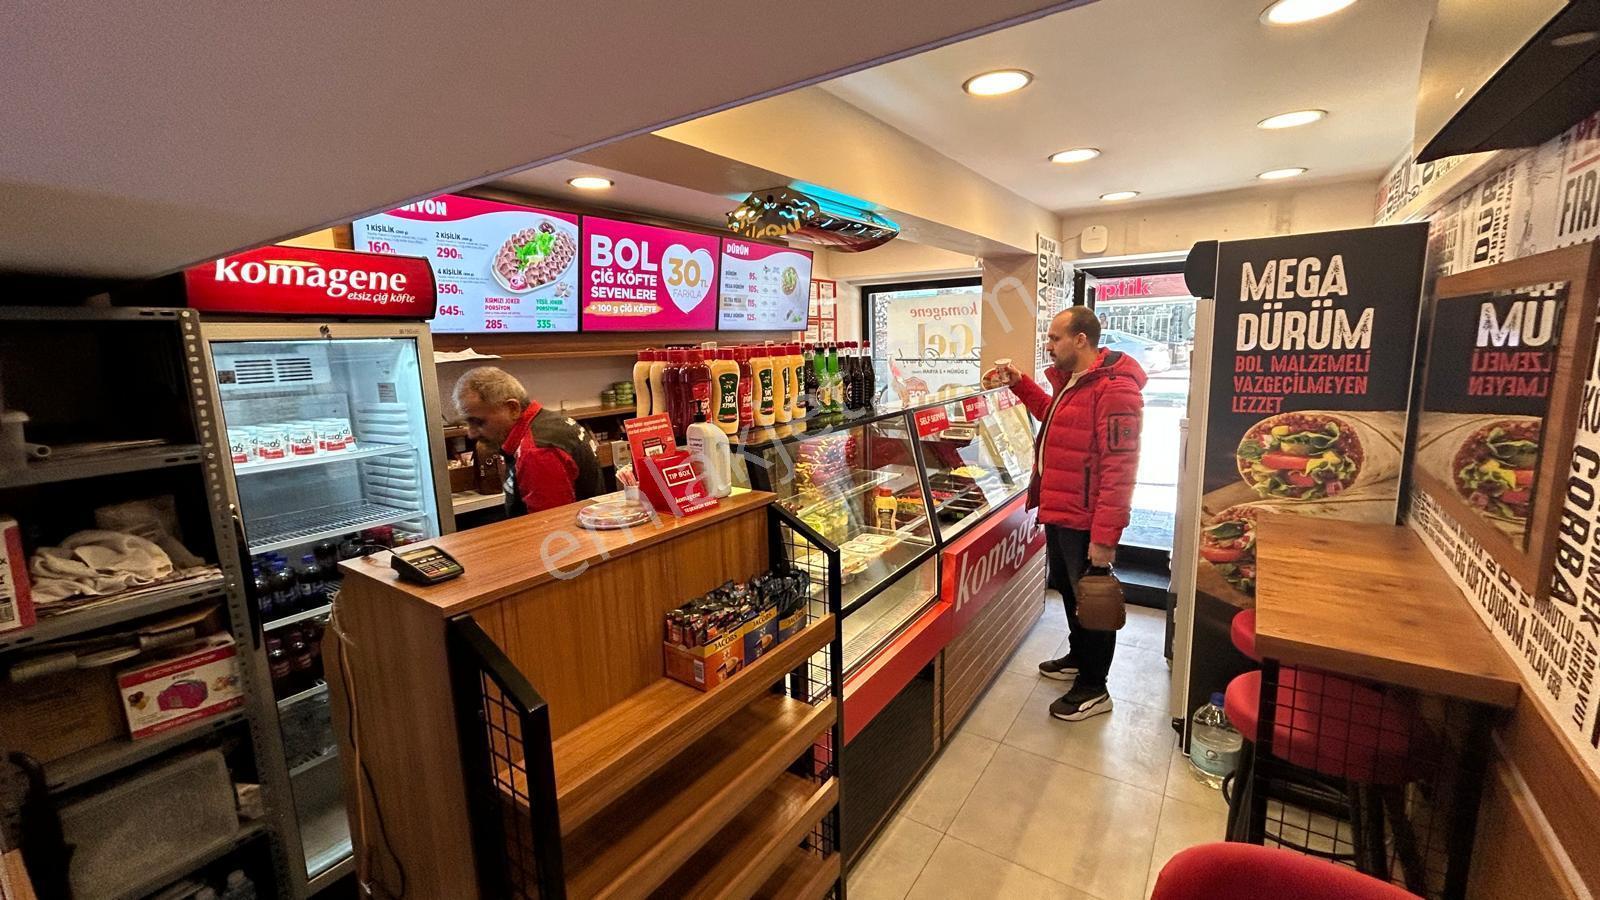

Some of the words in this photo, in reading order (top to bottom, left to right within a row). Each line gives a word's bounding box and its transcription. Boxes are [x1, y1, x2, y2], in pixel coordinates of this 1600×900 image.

[590, 234, 658, 271] BOL
[726, 243, 749, 256] DÜRÜM
[214, 258, 407, 298] komagene
[591, 268, 614, 285] ÇİĞ
[617, 269, 657, 287] KÖFTE
[1240, 254, 1348, 302] MEGA
[347, 291, 372, 302] etsiz
[372, 292, 389, 304] çiğ
[389, 292, 416, 304] köfte
[590, 286, 657, 301] SEVENLERE
[673, 288, 702, 299] FARKLA
[1095, 277, 1152, 302] ptik
[597, 304, 612, 312] 100
[1236, 299, 1375, 351] DÜRÜM
[1235, 355, 1264, 372] BOL
[1271, 350, 1371, 373] MALZEMELİ
[1233, 374, 1368, 394] VAZGEÇİLMEYEN
[1232, 397, 1284, 413] LEZZET
[919, 415, 931, 426] SELF
[752, 611, 772, 628] JACOBS
[713, 633, 738, 651] JACOBS
[1529, 612, 1568, 671] TAVUKLU
[1572, 639, 1598, 732] ARNAVUT
